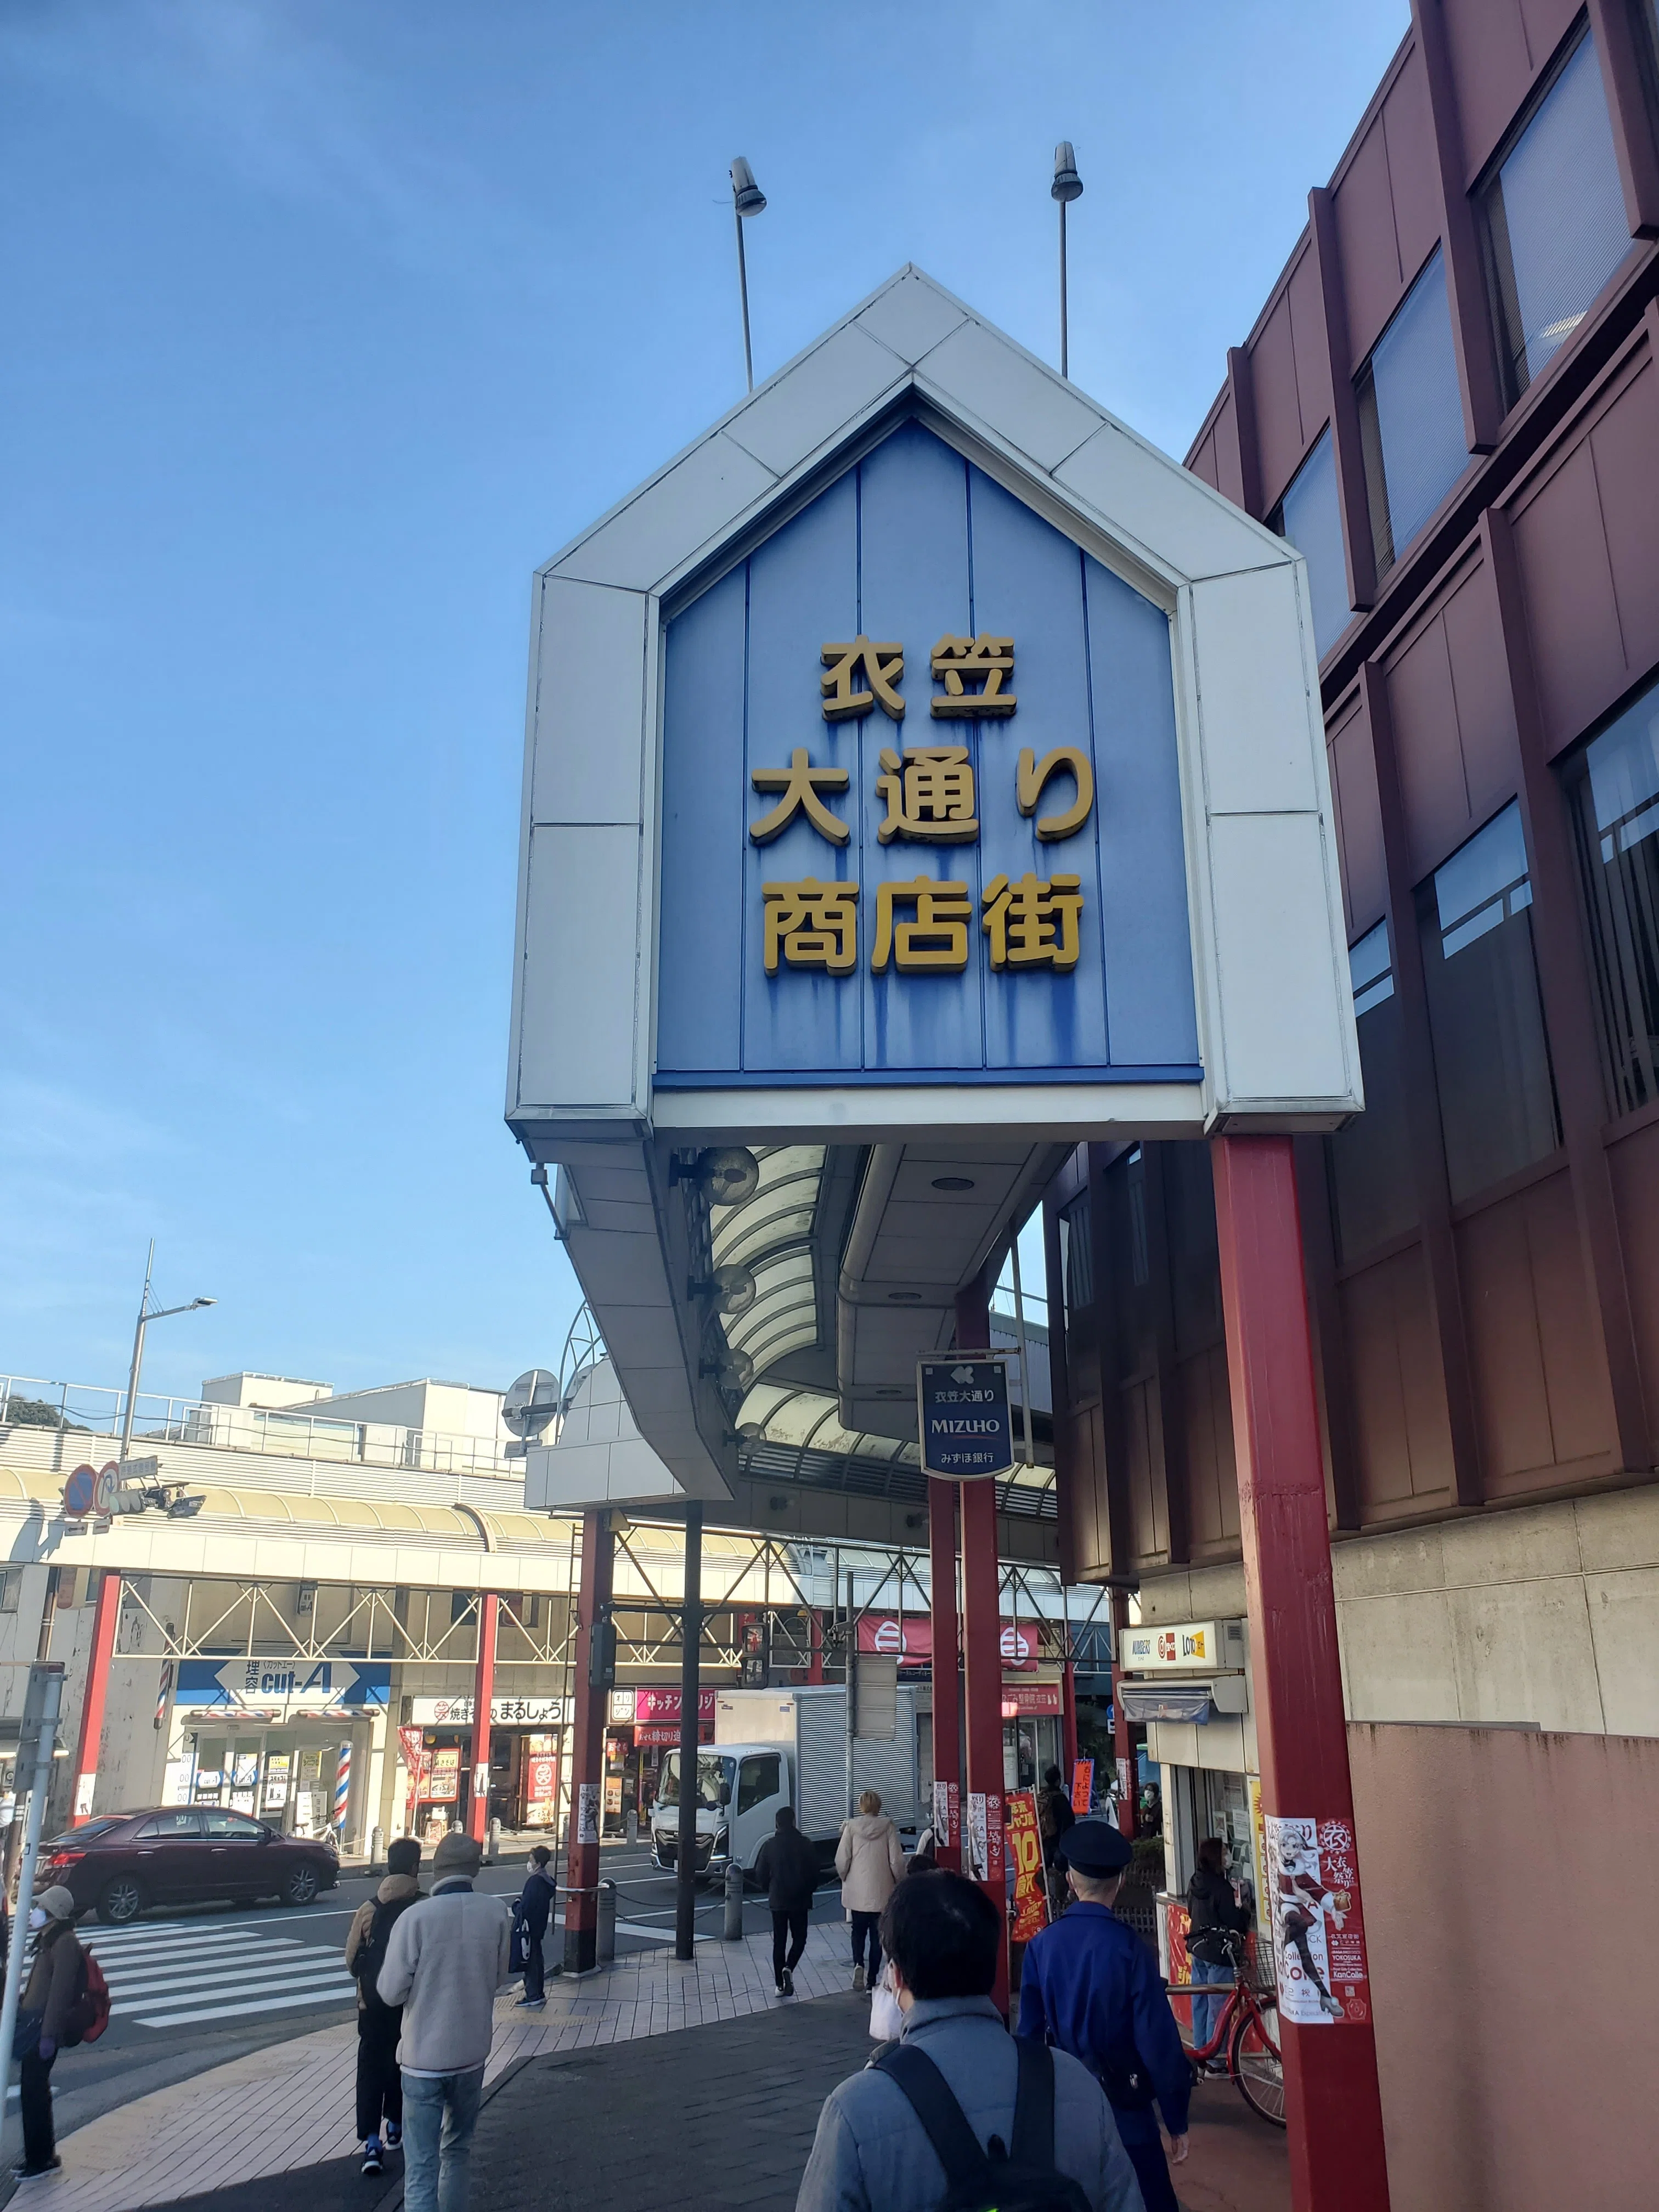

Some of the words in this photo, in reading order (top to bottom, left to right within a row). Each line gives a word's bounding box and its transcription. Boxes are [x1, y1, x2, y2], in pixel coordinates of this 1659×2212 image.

[821, 634, 1017, 721] 衣笠
[749, 746, 1093, 846] 大通り
[761, 872, 1084, 977] 商店街
[935, 1390, 994, 1403] 衣笠大通り
[931, 1419, 1000, 1434] MIZUHO
[941, 1453, 994, 1464] みずほ銀行
[1132, 1639, 1151, 1655] NUMBERS
[1182, 1634, 1196, 1657] LOTO
[245, 1661, 260, 1695] 理容
[261, 1662, 332, 1694] cut-A
[450, 1707, 497, 1721] 焼きの
[500, 1701, 561, 1720] まるしょう
[1323, 1825, 1347, 1850] 衣
[1012, 1830, 1039, 1875] 10
[1333, 1971, 1364, 1979] KanColle
